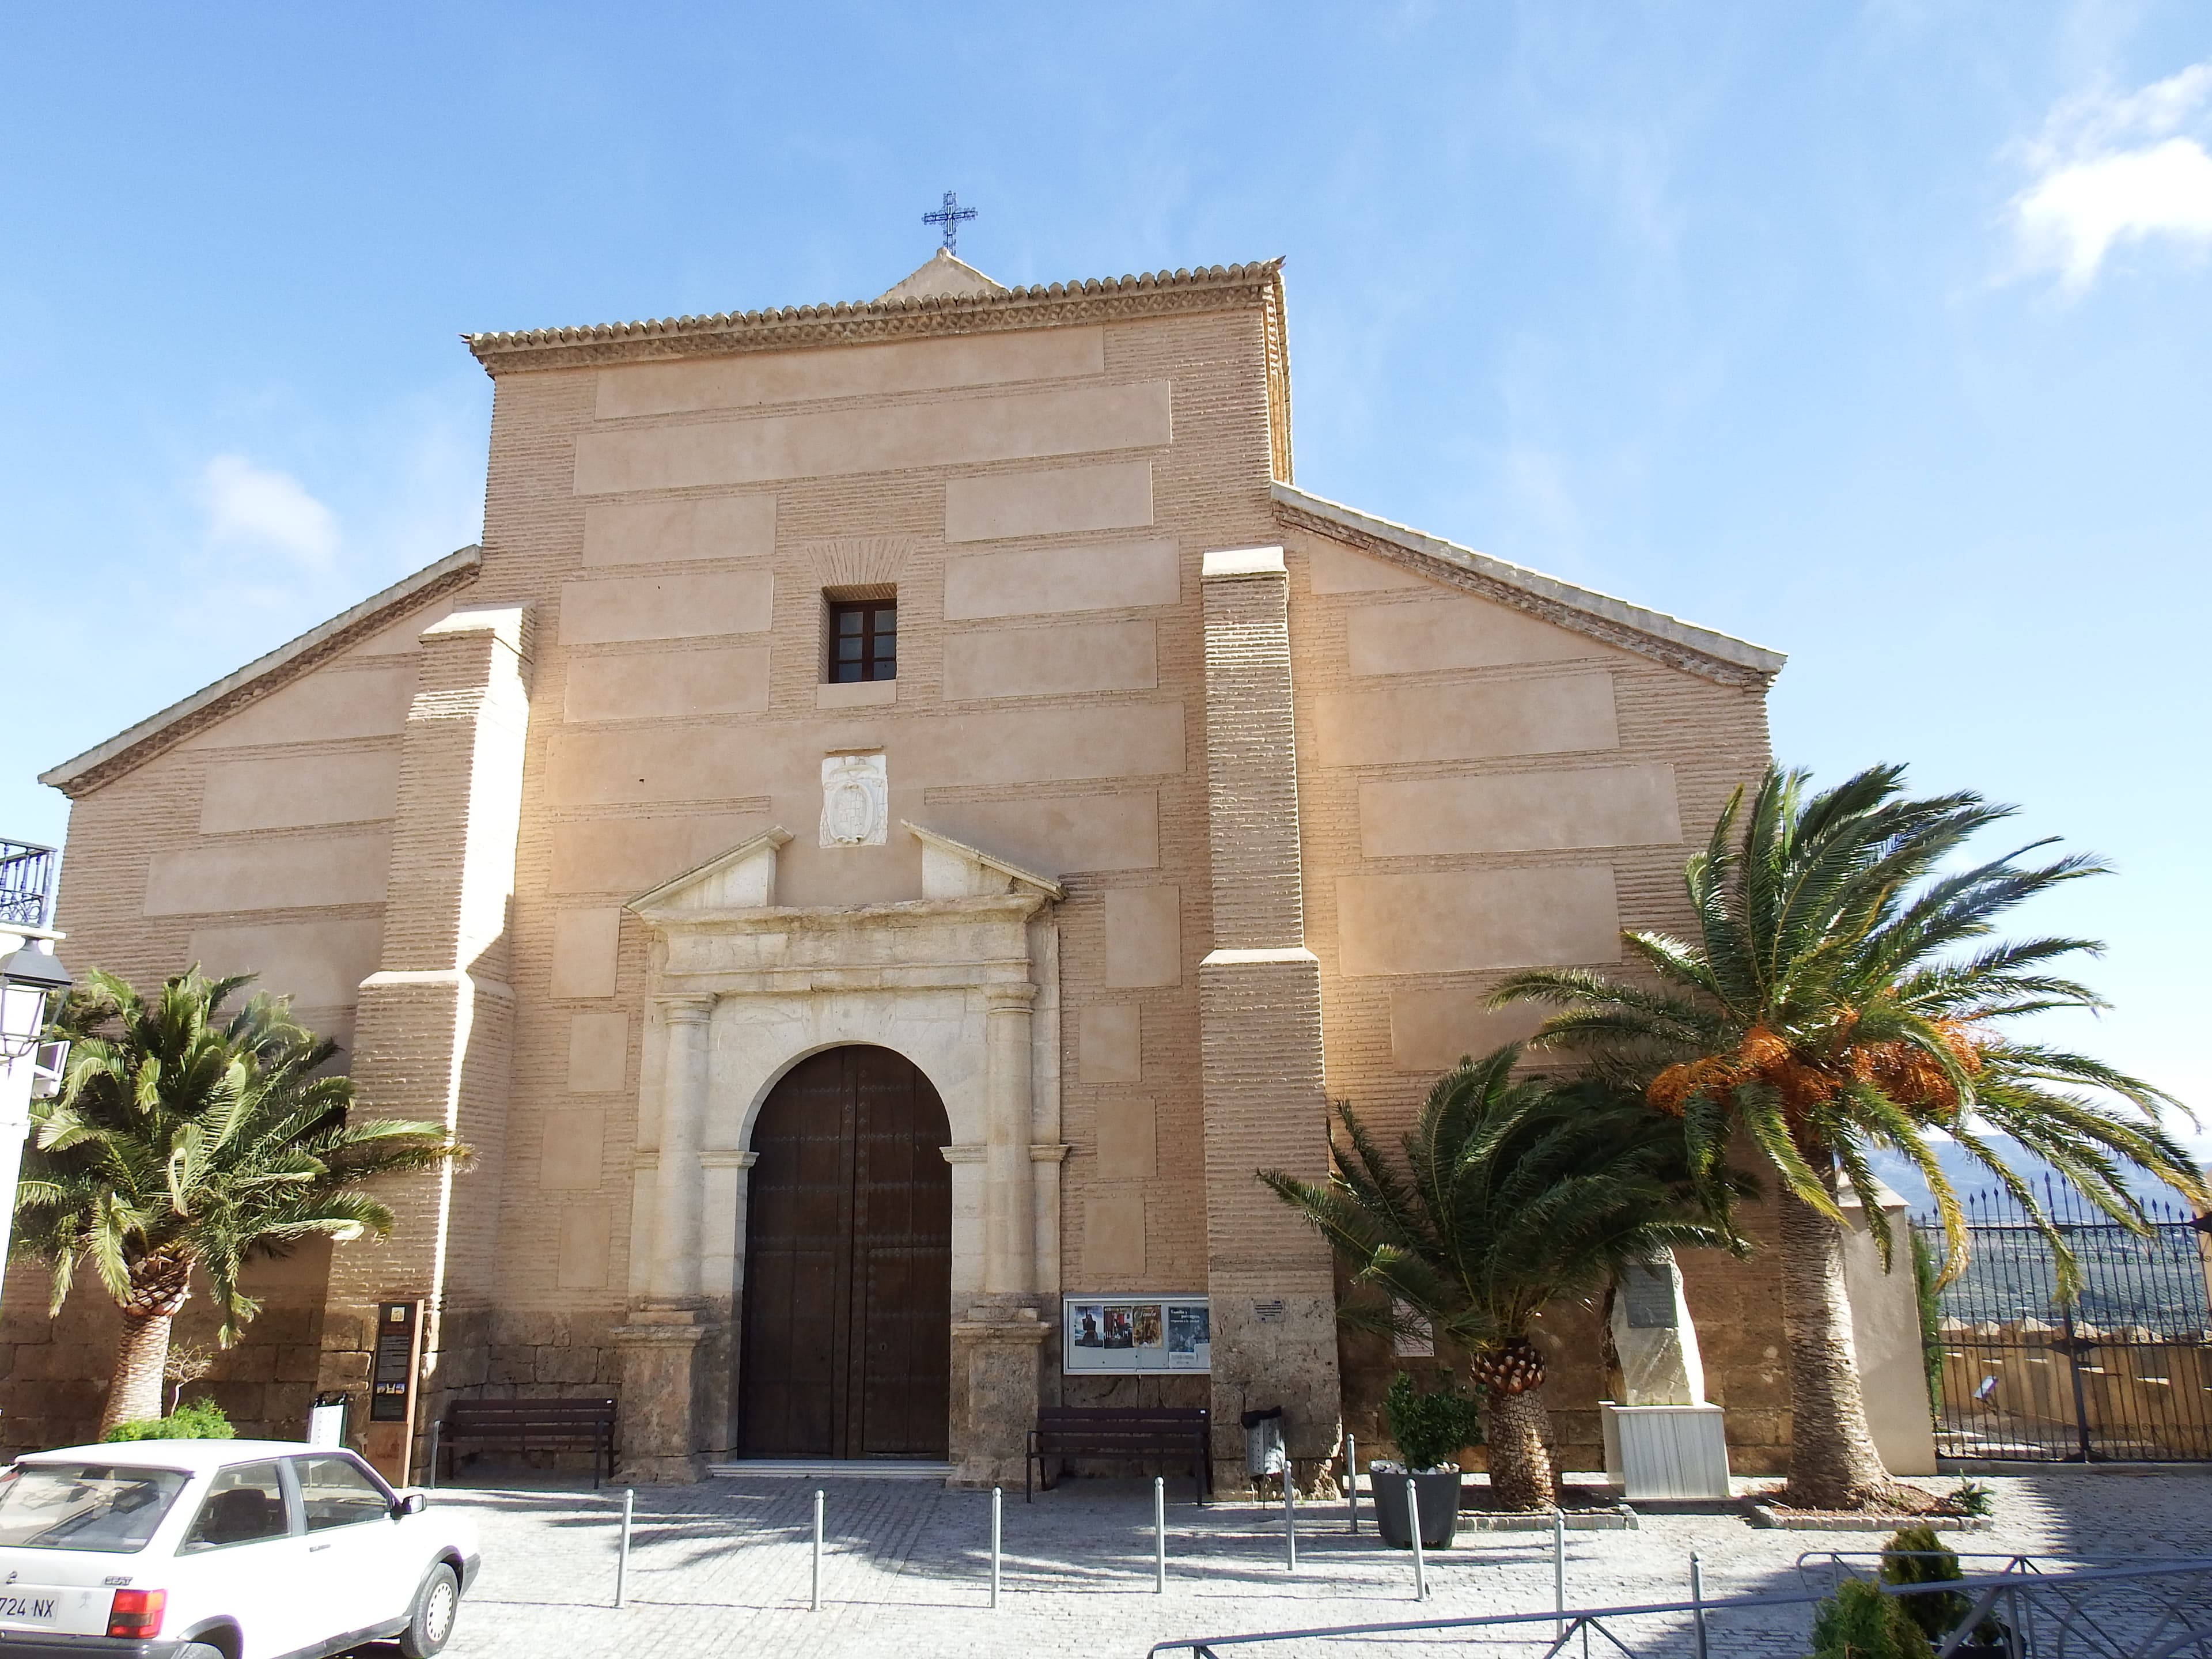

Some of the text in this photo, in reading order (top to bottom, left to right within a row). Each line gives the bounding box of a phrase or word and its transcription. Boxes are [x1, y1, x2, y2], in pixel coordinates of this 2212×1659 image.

[105, 1575, 133, 1585] SEAT
[0, 1597, 55, 1618] 724 NX
